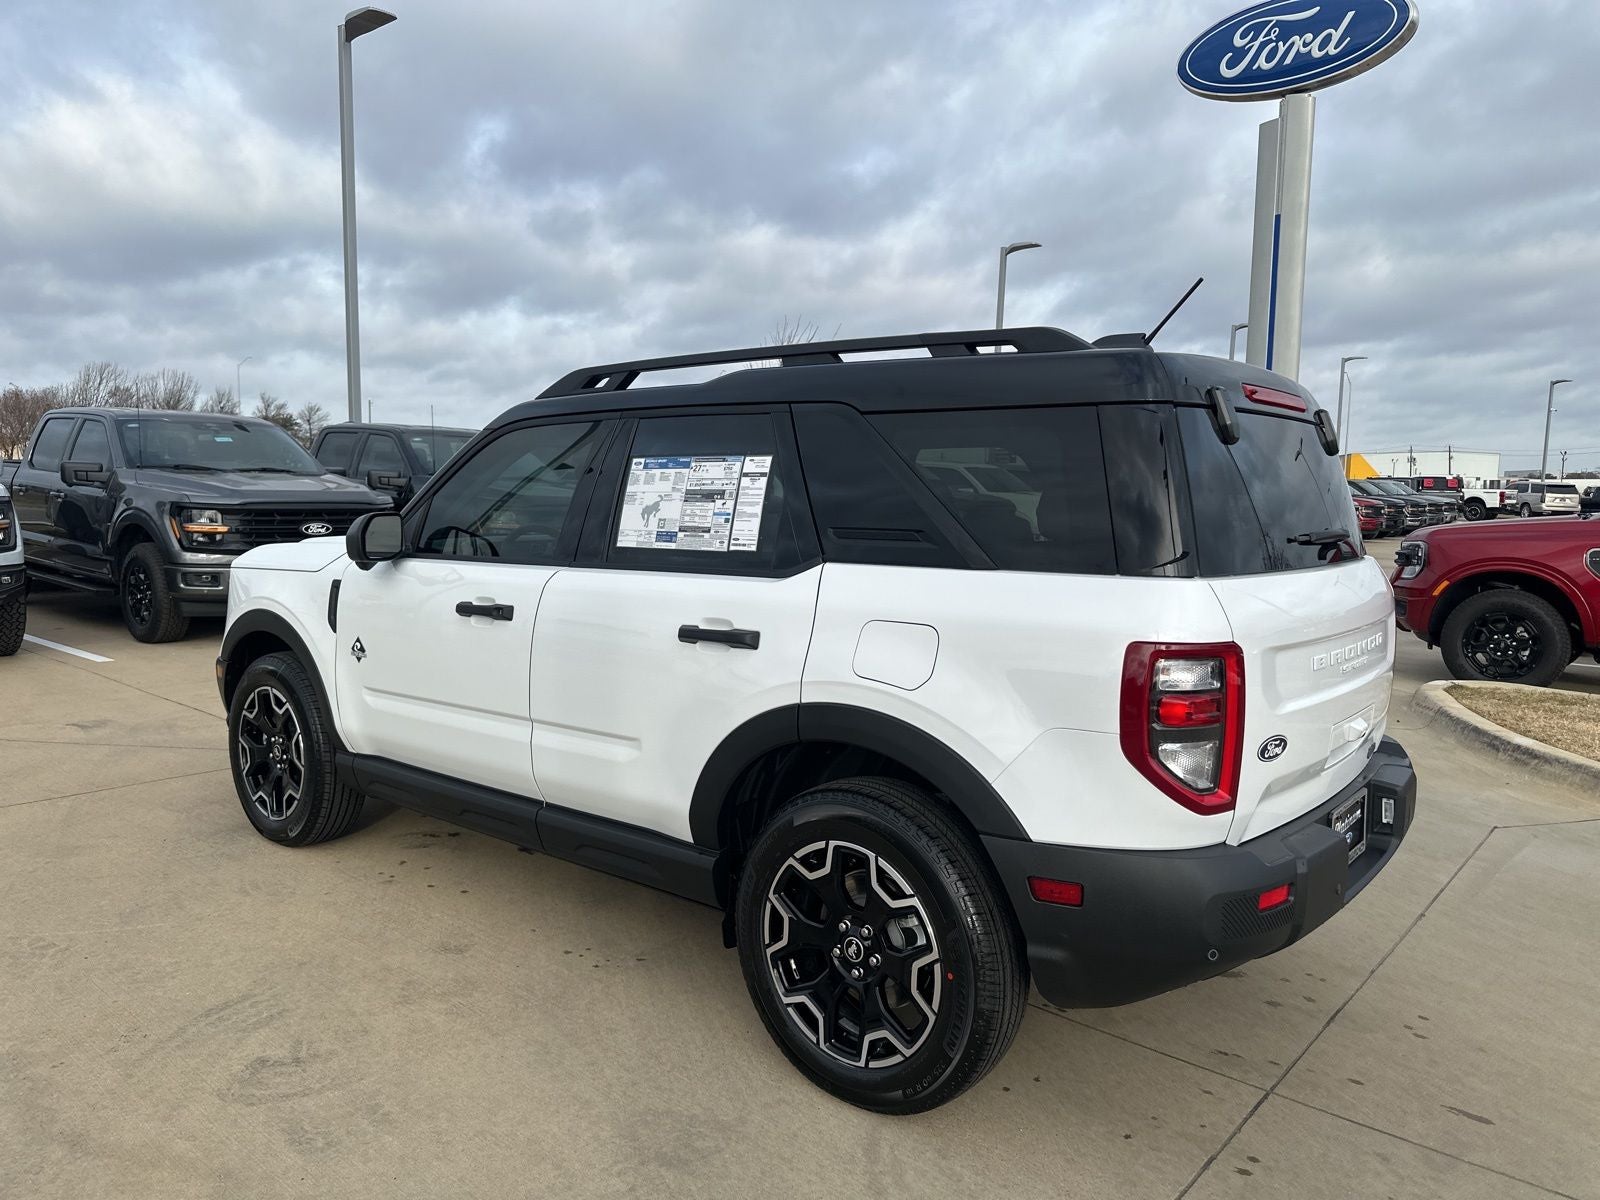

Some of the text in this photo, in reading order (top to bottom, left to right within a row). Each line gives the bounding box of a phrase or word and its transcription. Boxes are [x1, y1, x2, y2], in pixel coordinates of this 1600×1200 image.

[1219, 6, 1355, 78] Ford
[308, 524, 327, 533] Ford
[1312, 632, 1382, 671] BRONCO
[1264, 740, 1284, 758] Ford
